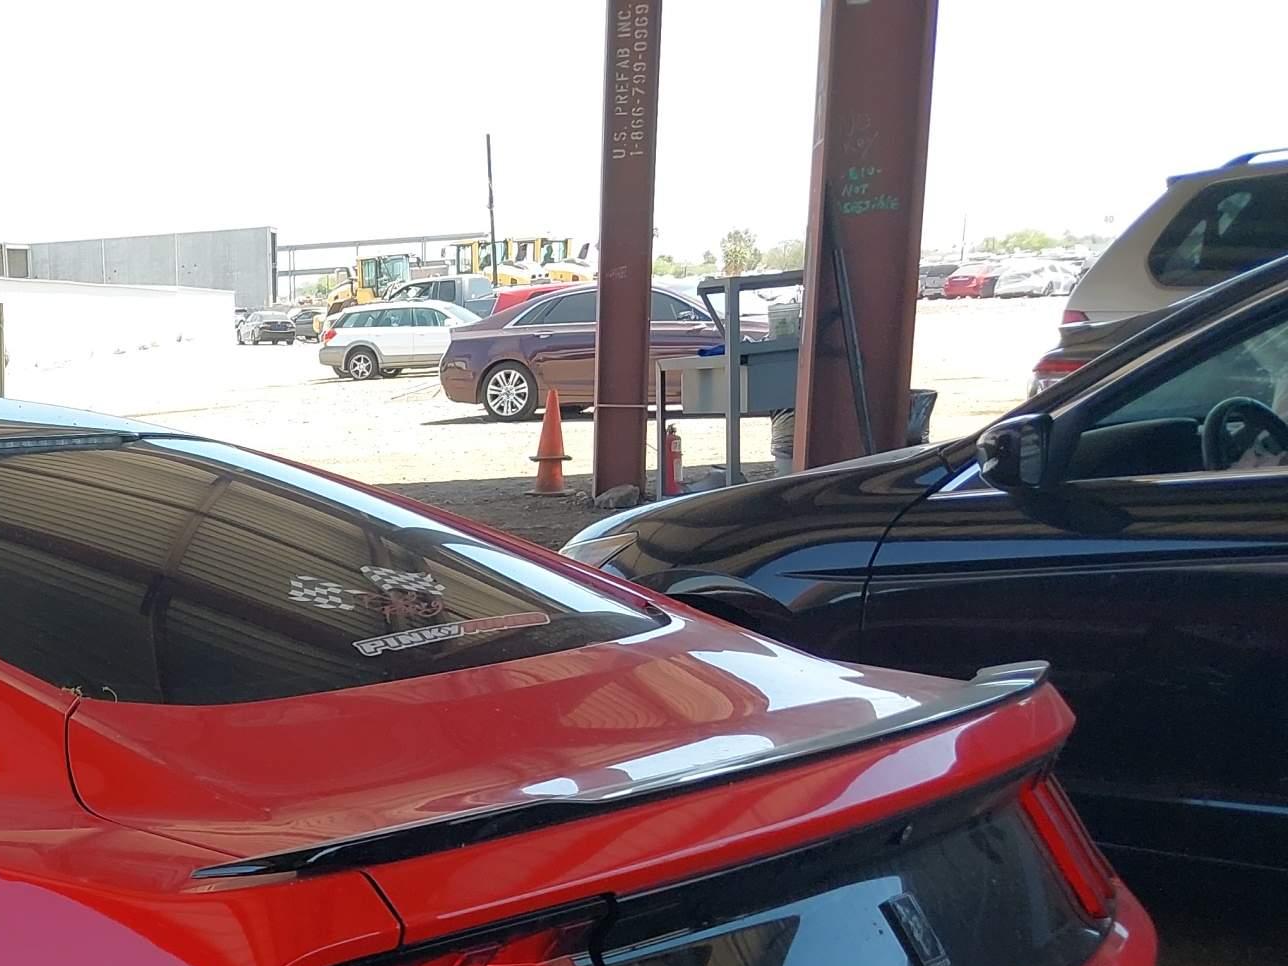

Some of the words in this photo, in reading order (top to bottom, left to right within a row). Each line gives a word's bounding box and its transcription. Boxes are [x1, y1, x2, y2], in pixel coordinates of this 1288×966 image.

[616, 3, 632, 38] INC.
[614, 47, 631, 116] PREFAB
[630, 4, 650, 157] 1-866-799-0969
[612, 126, 628, 160] U.S.
[355, 623, 461, 654] PINKY
